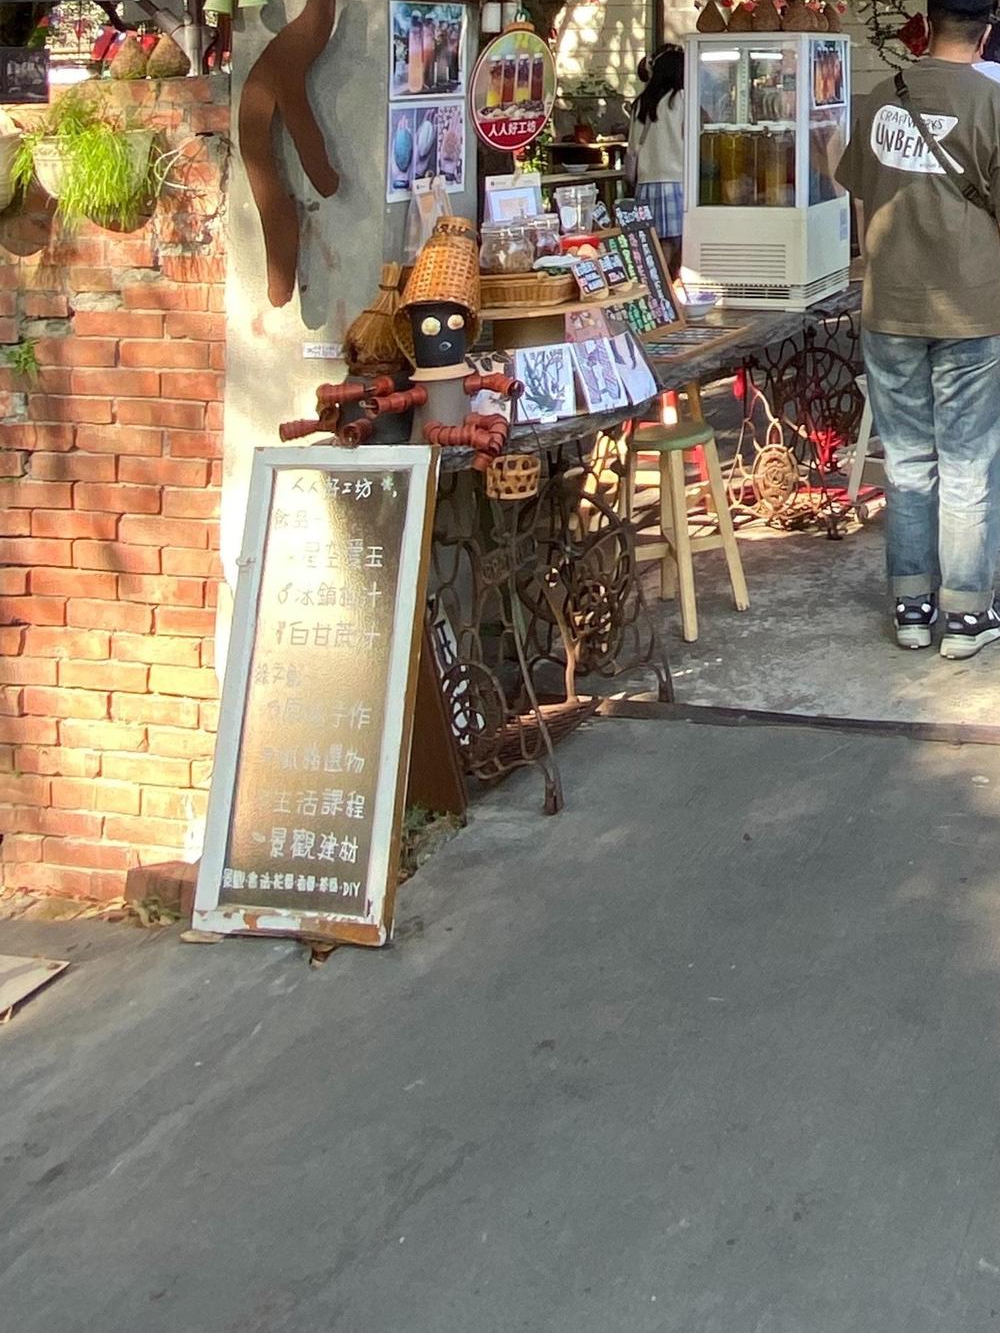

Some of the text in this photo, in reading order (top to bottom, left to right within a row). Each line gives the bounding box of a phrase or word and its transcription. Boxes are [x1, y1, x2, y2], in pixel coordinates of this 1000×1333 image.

[488, 119, 536, 137] 人人好工坊
[876, 122, 932, 159] UNBEN
[292, 475, 373, 501] 人人好工坊
[269, 825, 359, 865] 景觀建材
